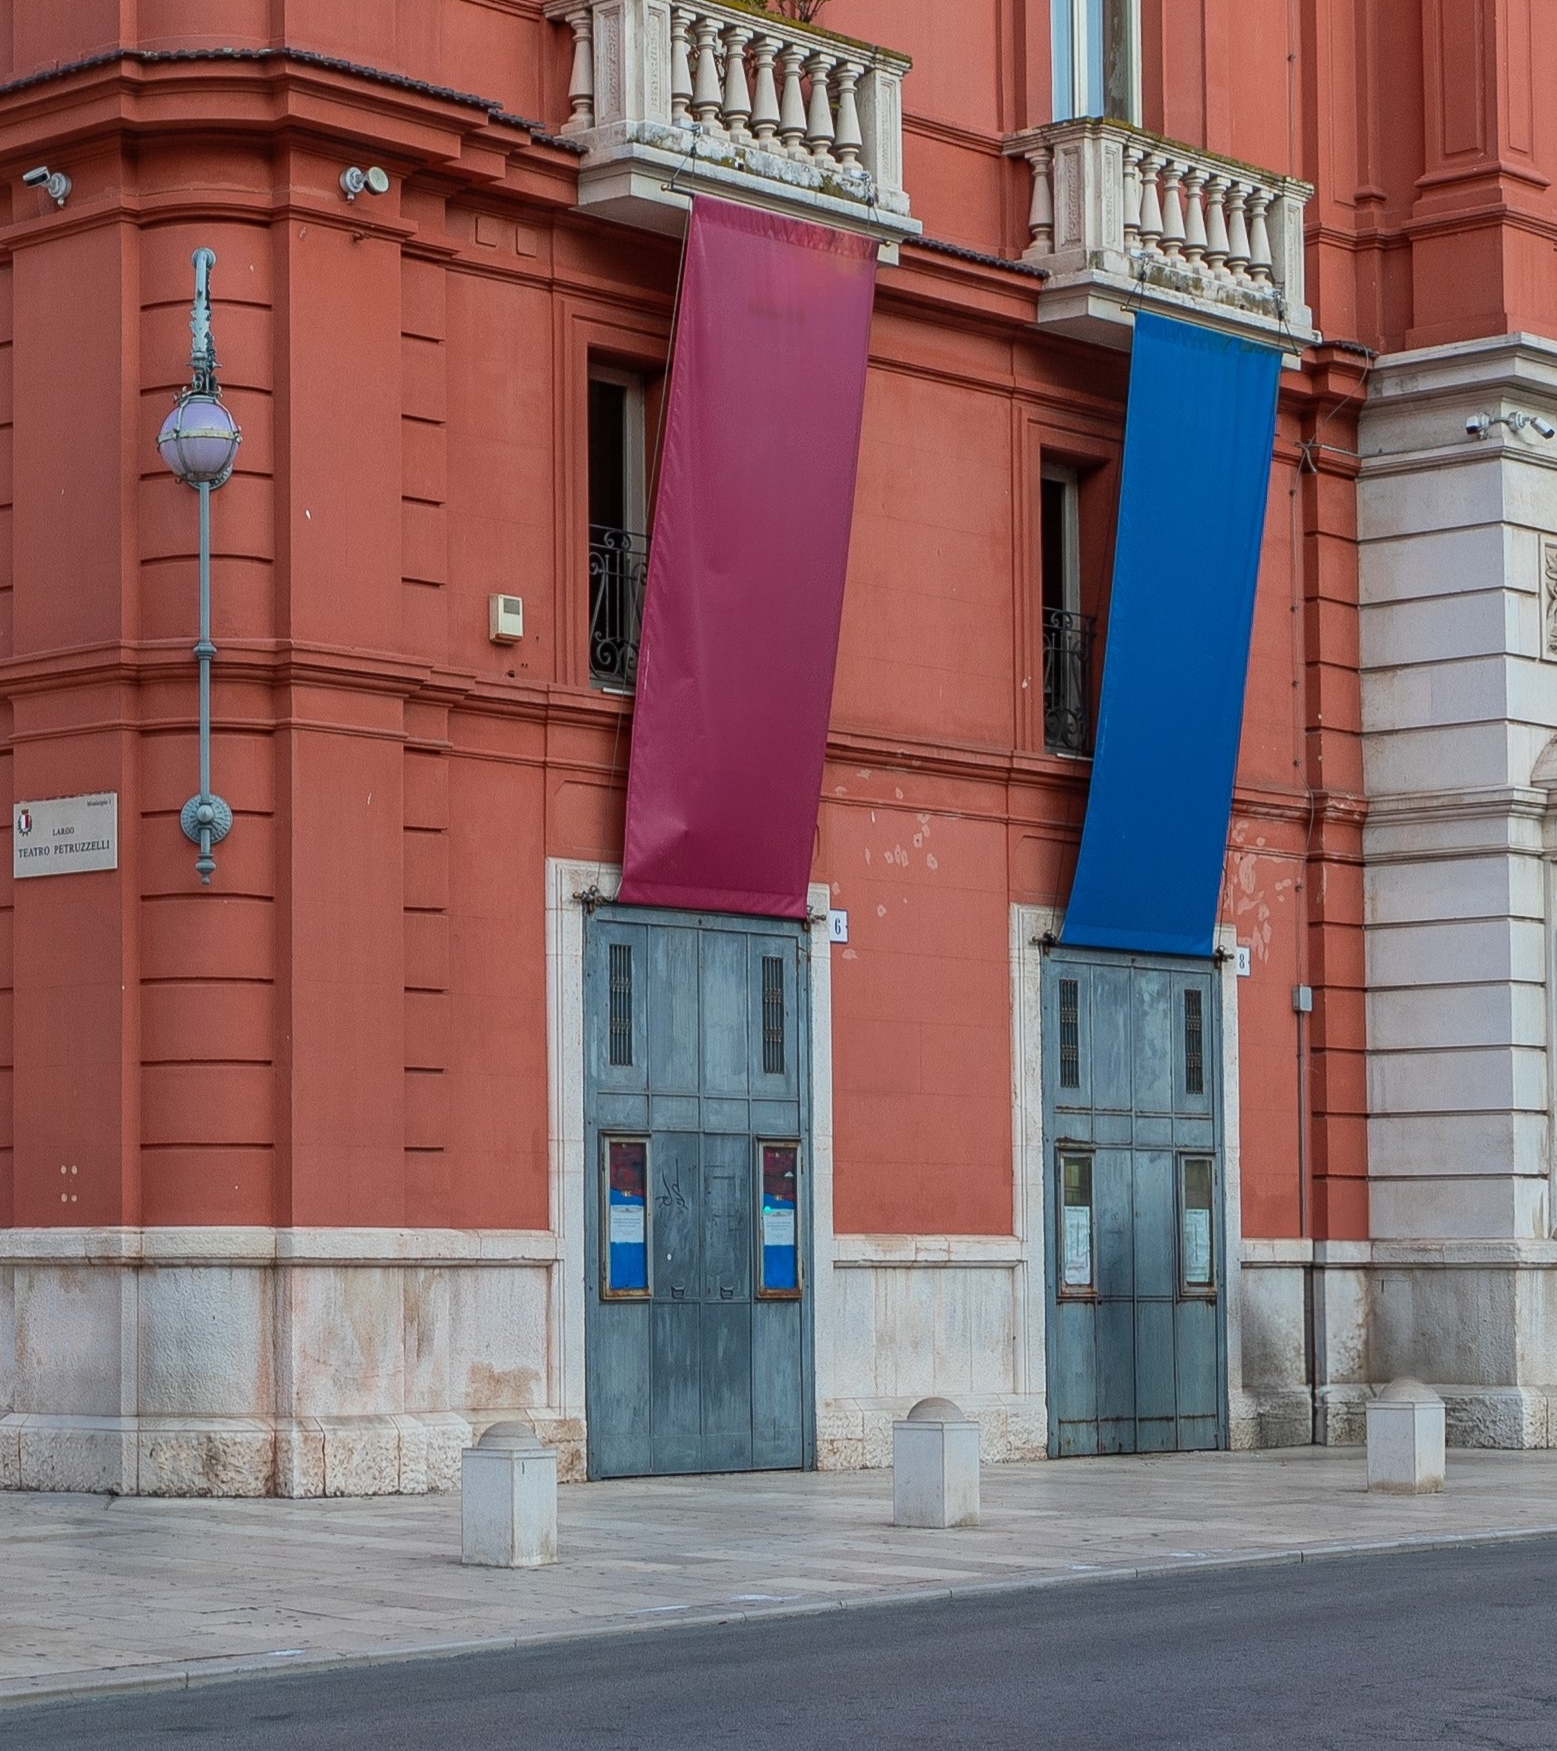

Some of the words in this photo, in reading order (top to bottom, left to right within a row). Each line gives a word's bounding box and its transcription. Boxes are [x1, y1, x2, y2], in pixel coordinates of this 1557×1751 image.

[52, 826, 75, 836] LARGO
[18, 846, 50, 858] TEATRO
[54, 840, 110, 855] PETRUZZELLI
[834, 917, 841, 935] 6
[1239, 953, 1245, 969] 8
